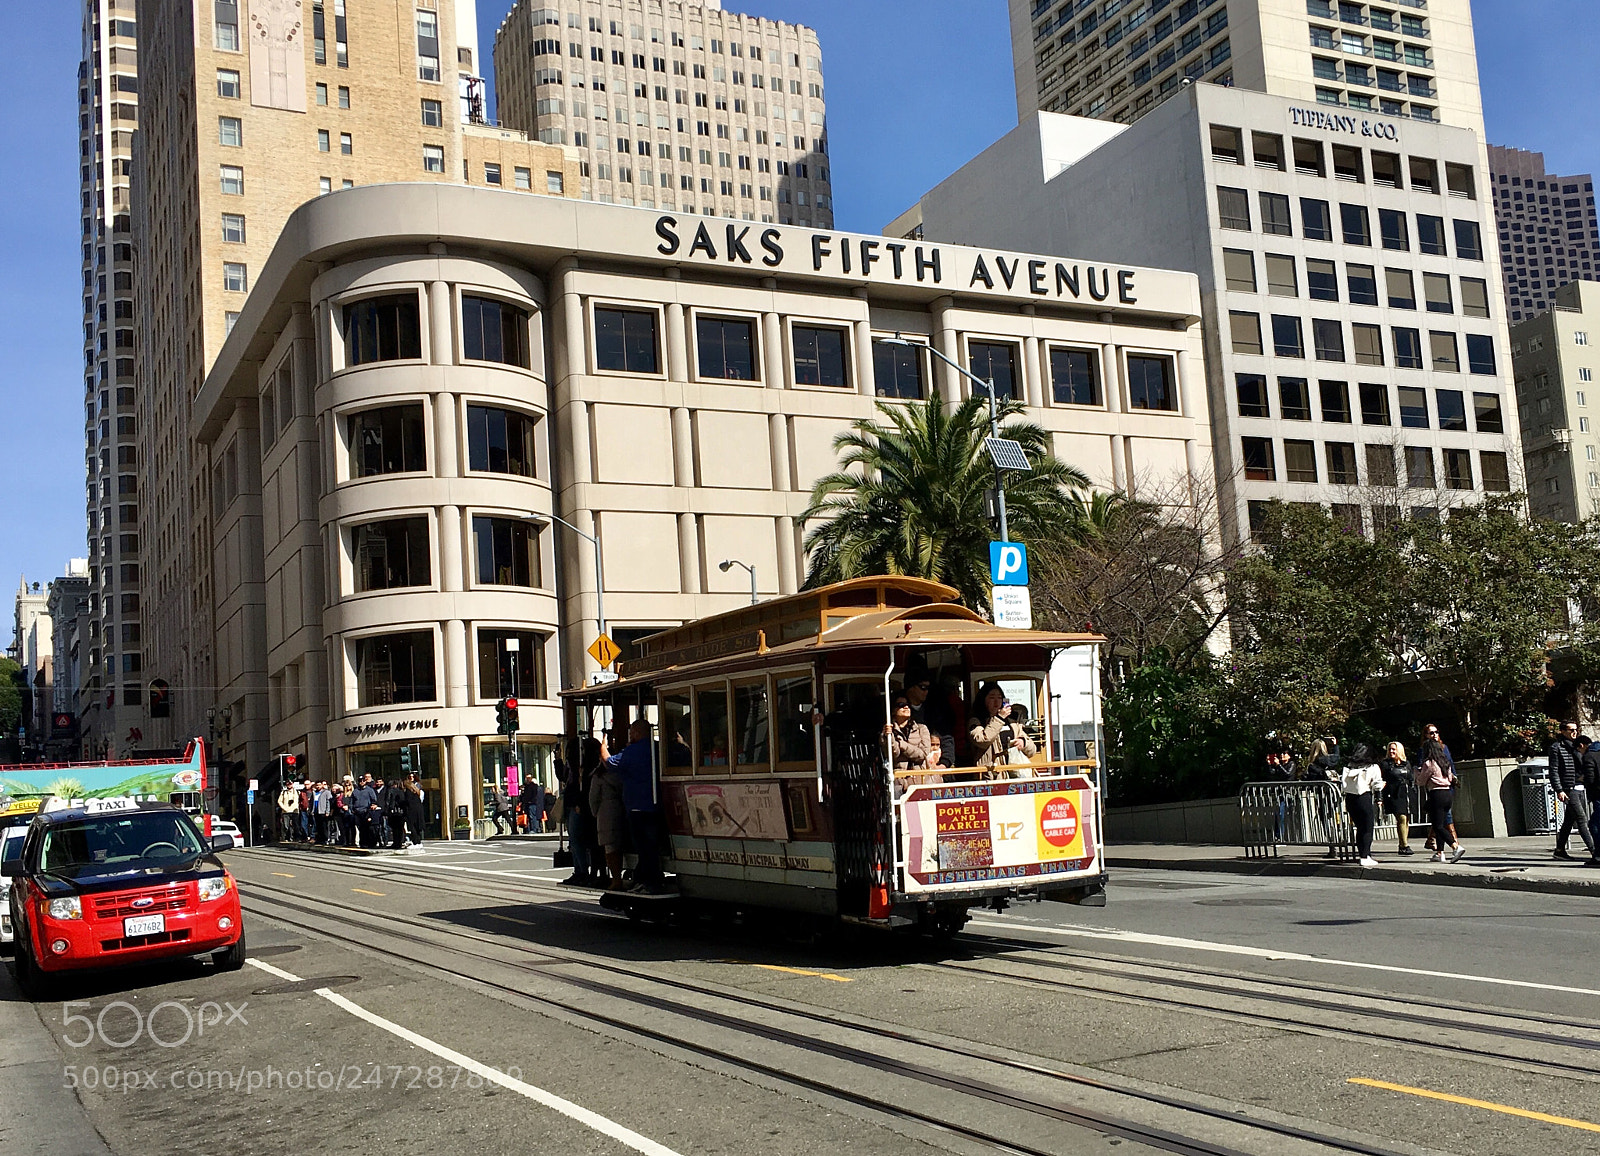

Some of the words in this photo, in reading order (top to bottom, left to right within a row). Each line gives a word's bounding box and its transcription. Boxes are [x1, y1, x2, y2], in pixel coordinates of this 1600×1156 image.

[1289, 106, 1356, 134] TIFFANY
[1361, 120, 1373, 137] &
[655, 216, 784, 266] SAKS
[811, 234, 942, 284] FIFTH
[969, 253, 1137, 303] AVENUE
[363, 723, 392, 736] FIFTH
[395, 718, 439, 732] AVENUE
[931, 785, 994, 799] MARKET
[1008, 780, 1061, 795] STREET
[97, 800, 126, 811] TAXI
[938, 805, 987, 817] POWELL
[1047, 804, 1057, 812] DO
[1057, 803, 1071, 811] NOT
[952, 814, 976, 822] AND
[1051, 811, 1068, 819] PASS
[938, 820, 988, 831] MARKET
[997, 822, 1024, 841] 17
[1044, 829, 1063, 838] CABLE
[1063, 828, 1076, 836] CAR
[689, 850, 701, 859] SAN
[927, 865, 1027, 884] FISHERMANS
[1040, 860, 1083, 875] WHARF
